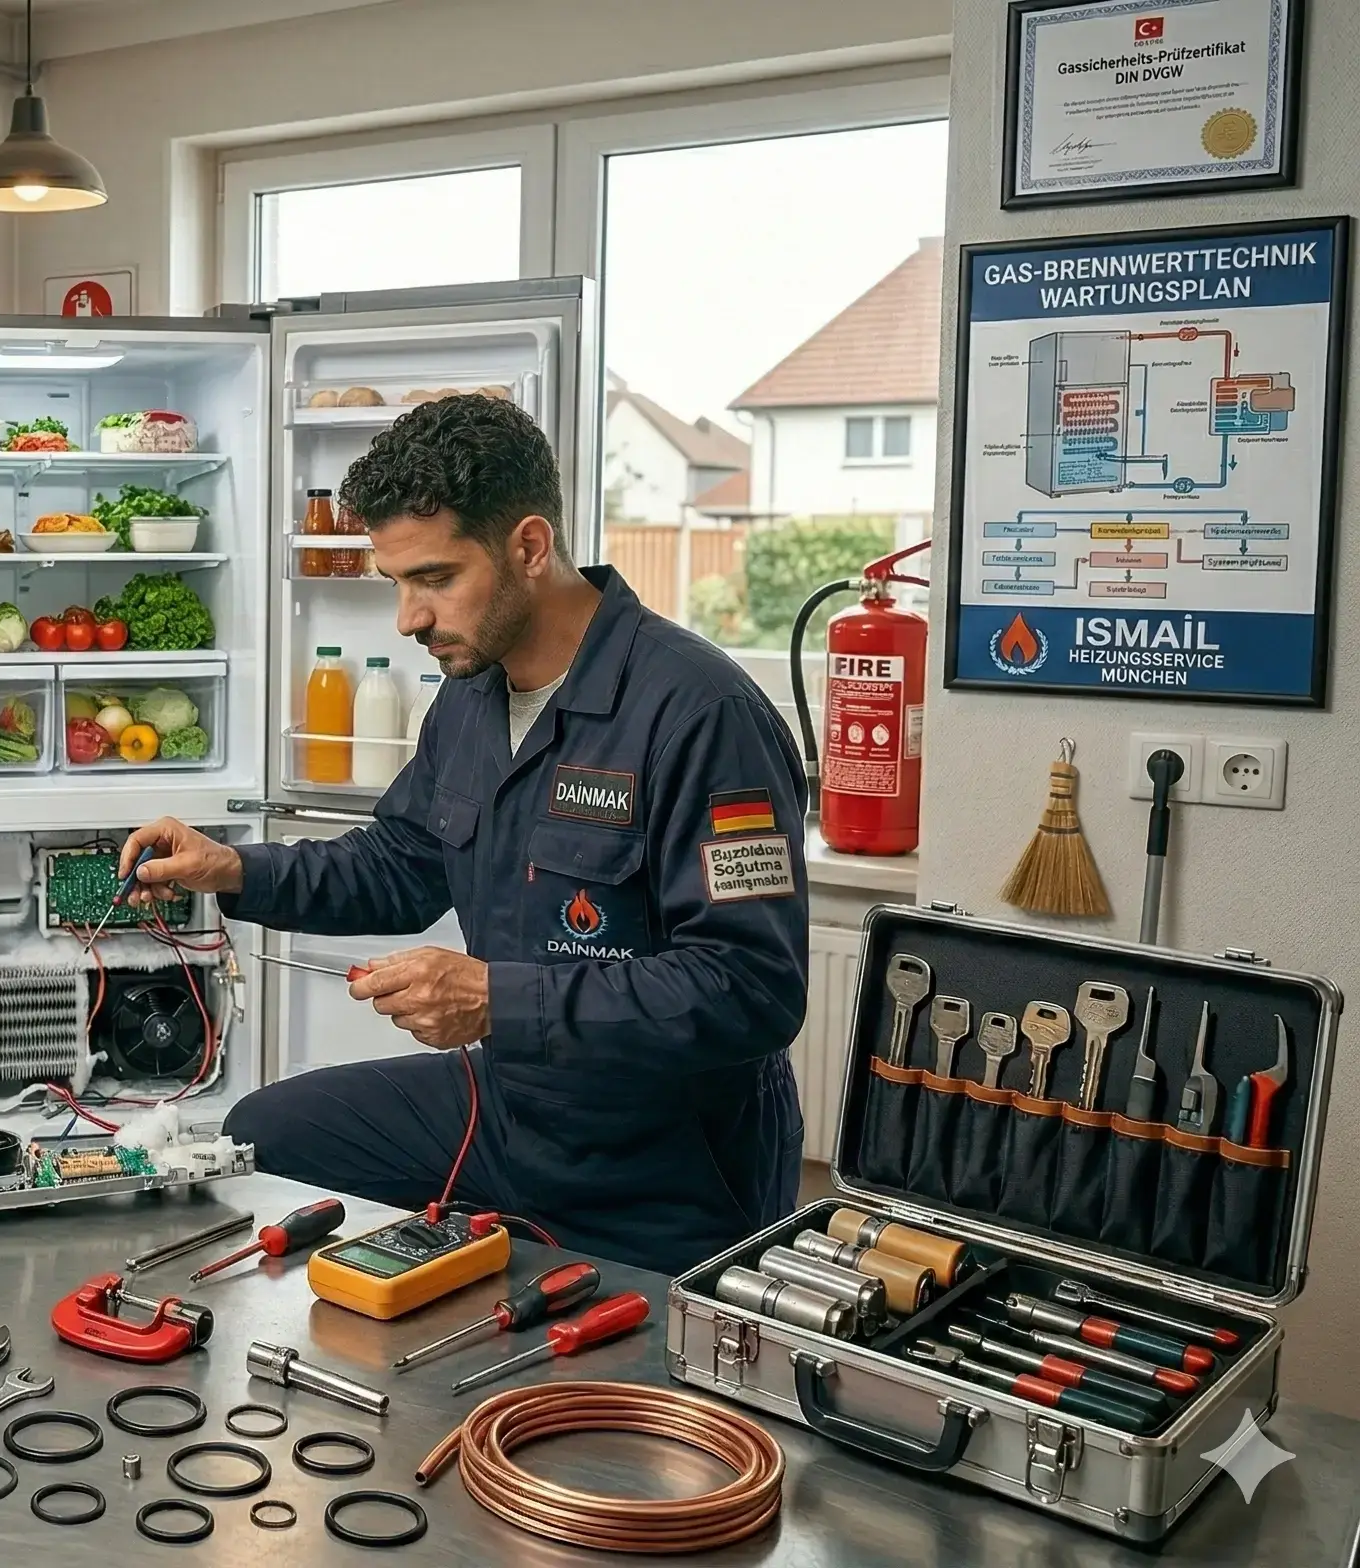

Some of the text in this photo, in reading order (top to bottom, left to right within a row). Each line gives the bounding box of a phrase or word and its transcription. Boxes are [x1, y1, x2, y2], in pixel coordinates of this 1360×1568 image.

[1058, 41, 1246, 75] Gassicherheits-Prüfzertifikat
[1115, 65, 1184, 85] DIN DVGW
[984, 242, 1317, 285] GAS-BRENNWERTTECHNIK
[1040, 276, 1251, 309] WARTUNGSPLAN
[835, 657, 892, 678] FIRE
[1069, 649, 1225, 669] HEIZUNGSSERVICE
[1101, 665, 1187, 686] MÜNCHEN
